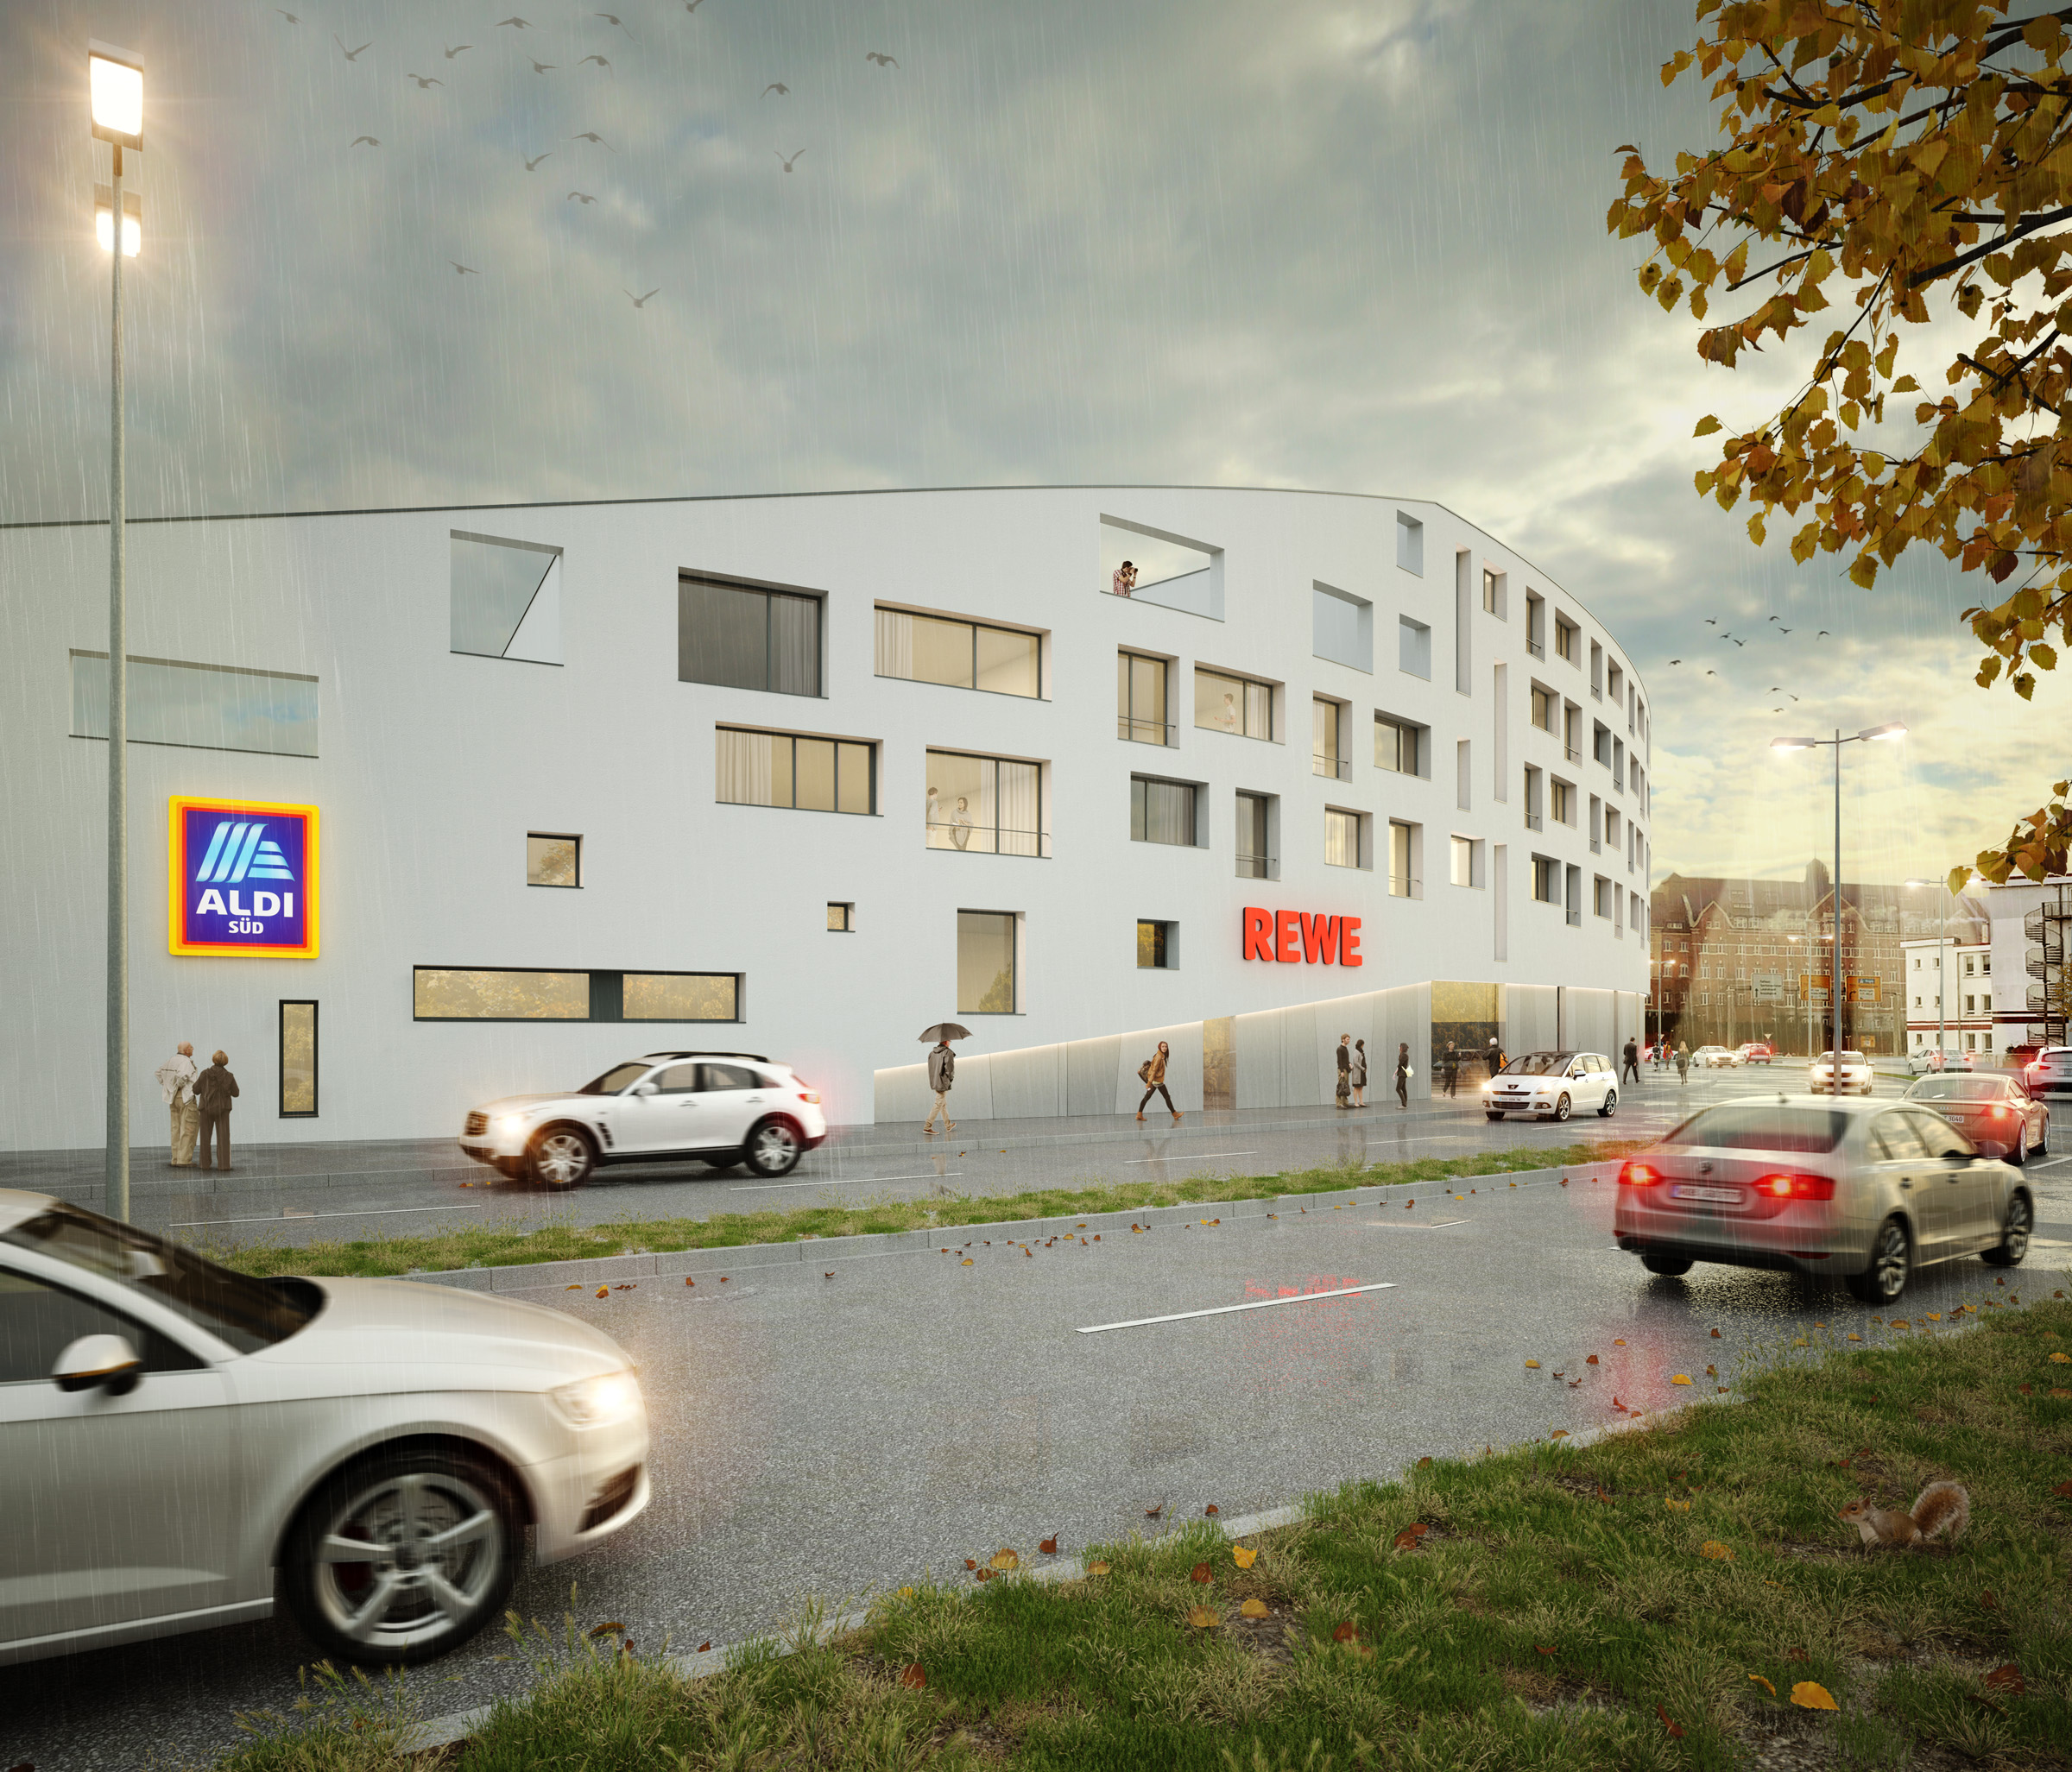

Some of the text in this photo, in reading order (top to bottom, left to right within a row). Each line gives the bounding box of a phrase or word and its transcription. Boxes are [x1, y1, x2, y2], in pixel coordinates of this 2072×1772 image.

[196, 888, 294, 918] ALDI
[228, 917, 264, 935] SÜD
[1243, 906, 1362, 967] REWE
